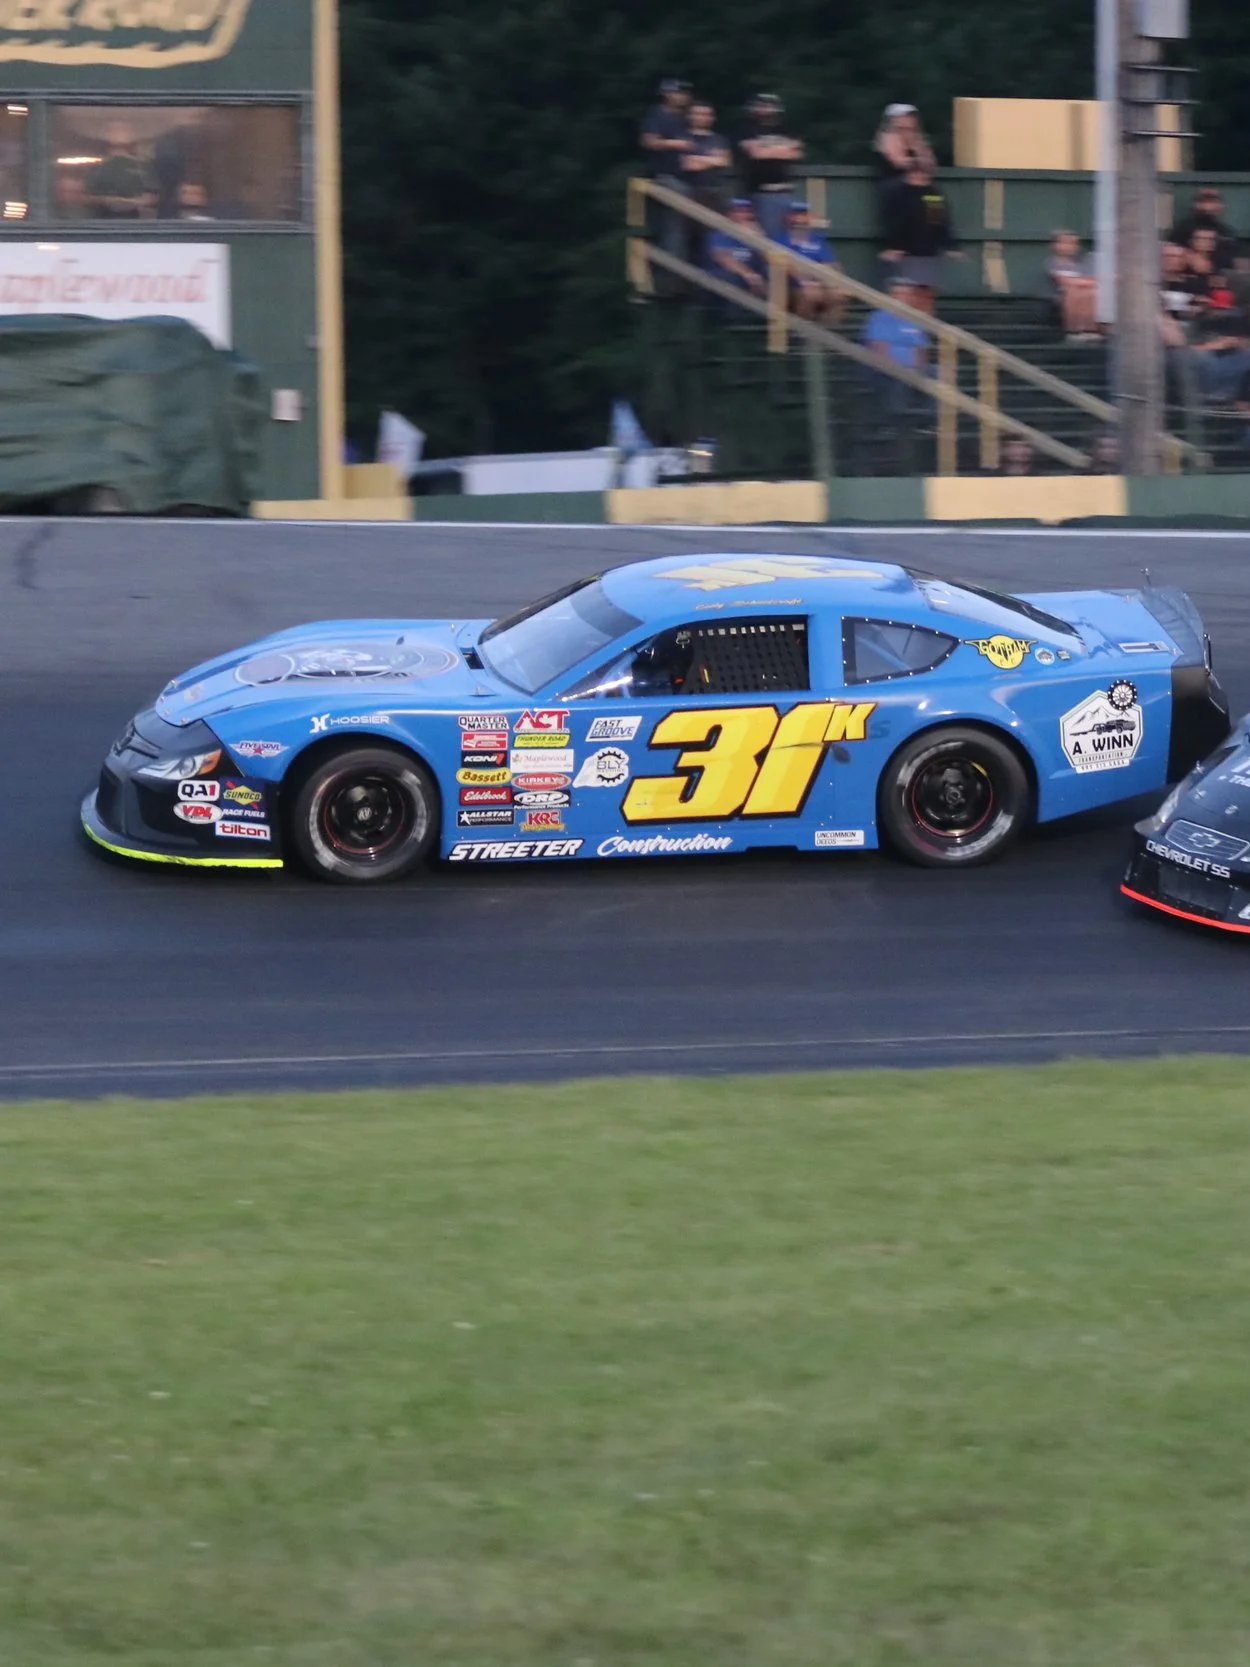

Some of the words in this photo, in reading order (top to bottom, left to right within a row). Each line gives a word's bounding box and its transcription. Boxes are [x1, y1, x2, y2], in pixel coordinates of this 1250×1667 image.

[979, 640, 1029, 659] GOTHAM
[330, 715, 390, 725] HOOSIER
[460, 716, 505, 725] QUARTER
[515, 710, 569, 729] ACT
[595, 720, 622, 728] FAST
[591, 727, 635, 736] GROOVE
[1092, 733, 1133, 752] WINN
[597, 760, 625, 770] BLY
[462, 771, 507, 782] Bassett
[181, 784, 216, 798] QA1
[225, 790, 261, 800] SUNOCO
[464, 791, 507, 801] Edelbrock
[523, 793, 561, 802] DRP
[244, 809, 265, 818] FUELS
[528, 812, 559, 825] KRC
[220, 823, 267, 837] tilton
[449, 839, 584, 860] STREETER
[597, 834, 733, 856] Construction
[1146, 840, 1212, 872] CHEVROLET
